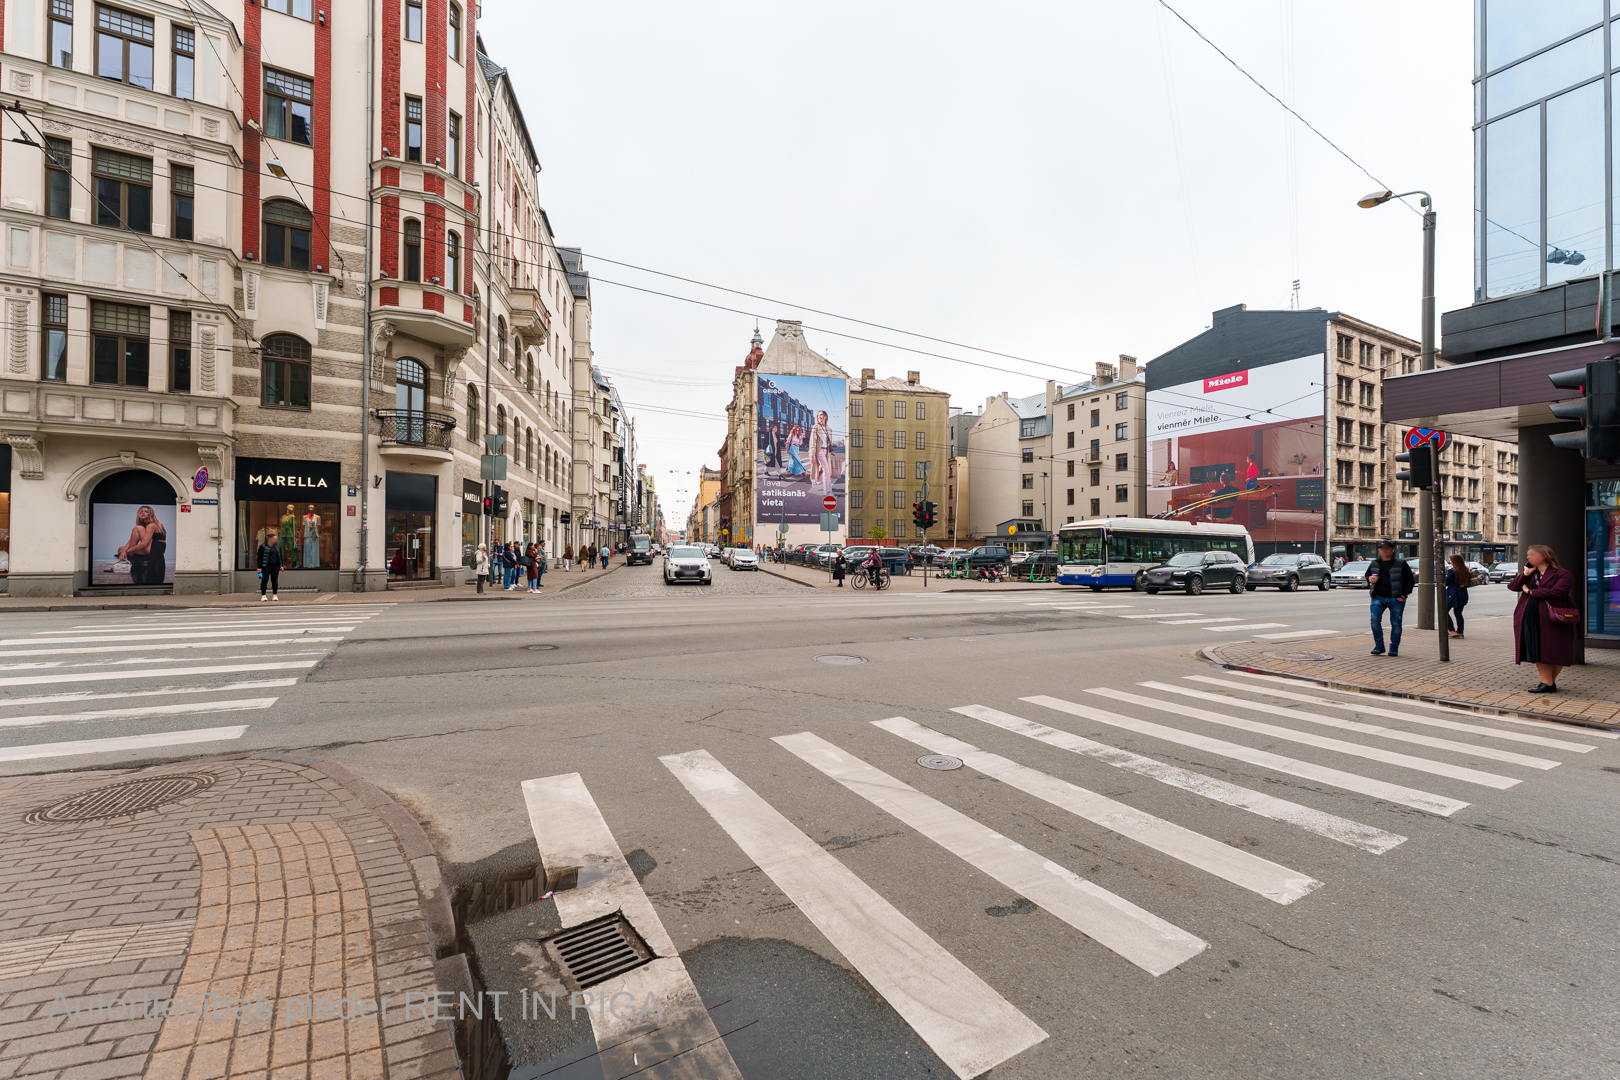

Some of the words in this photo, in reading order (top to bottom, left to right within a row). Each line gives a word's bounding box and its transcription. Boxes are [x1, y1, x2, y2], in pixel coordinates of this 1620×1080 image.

[1208, 375, 1243, 388] Miele
[1157, 408, 1188, 420] Vienreiz
[1190, 403, 1216, 416] Miele,
[1157, 418, 1192, 431] vienmēr
[1193, 414, 1222, 425] Miele.
[249, 474, 328, 488] MARELLA
[762, 479, 781, 487] Tava
[464, 492, 480, 503] MARELLA
[762, 488, 806, 497] satikšanās
[762, 499, 784, 507] vieta
